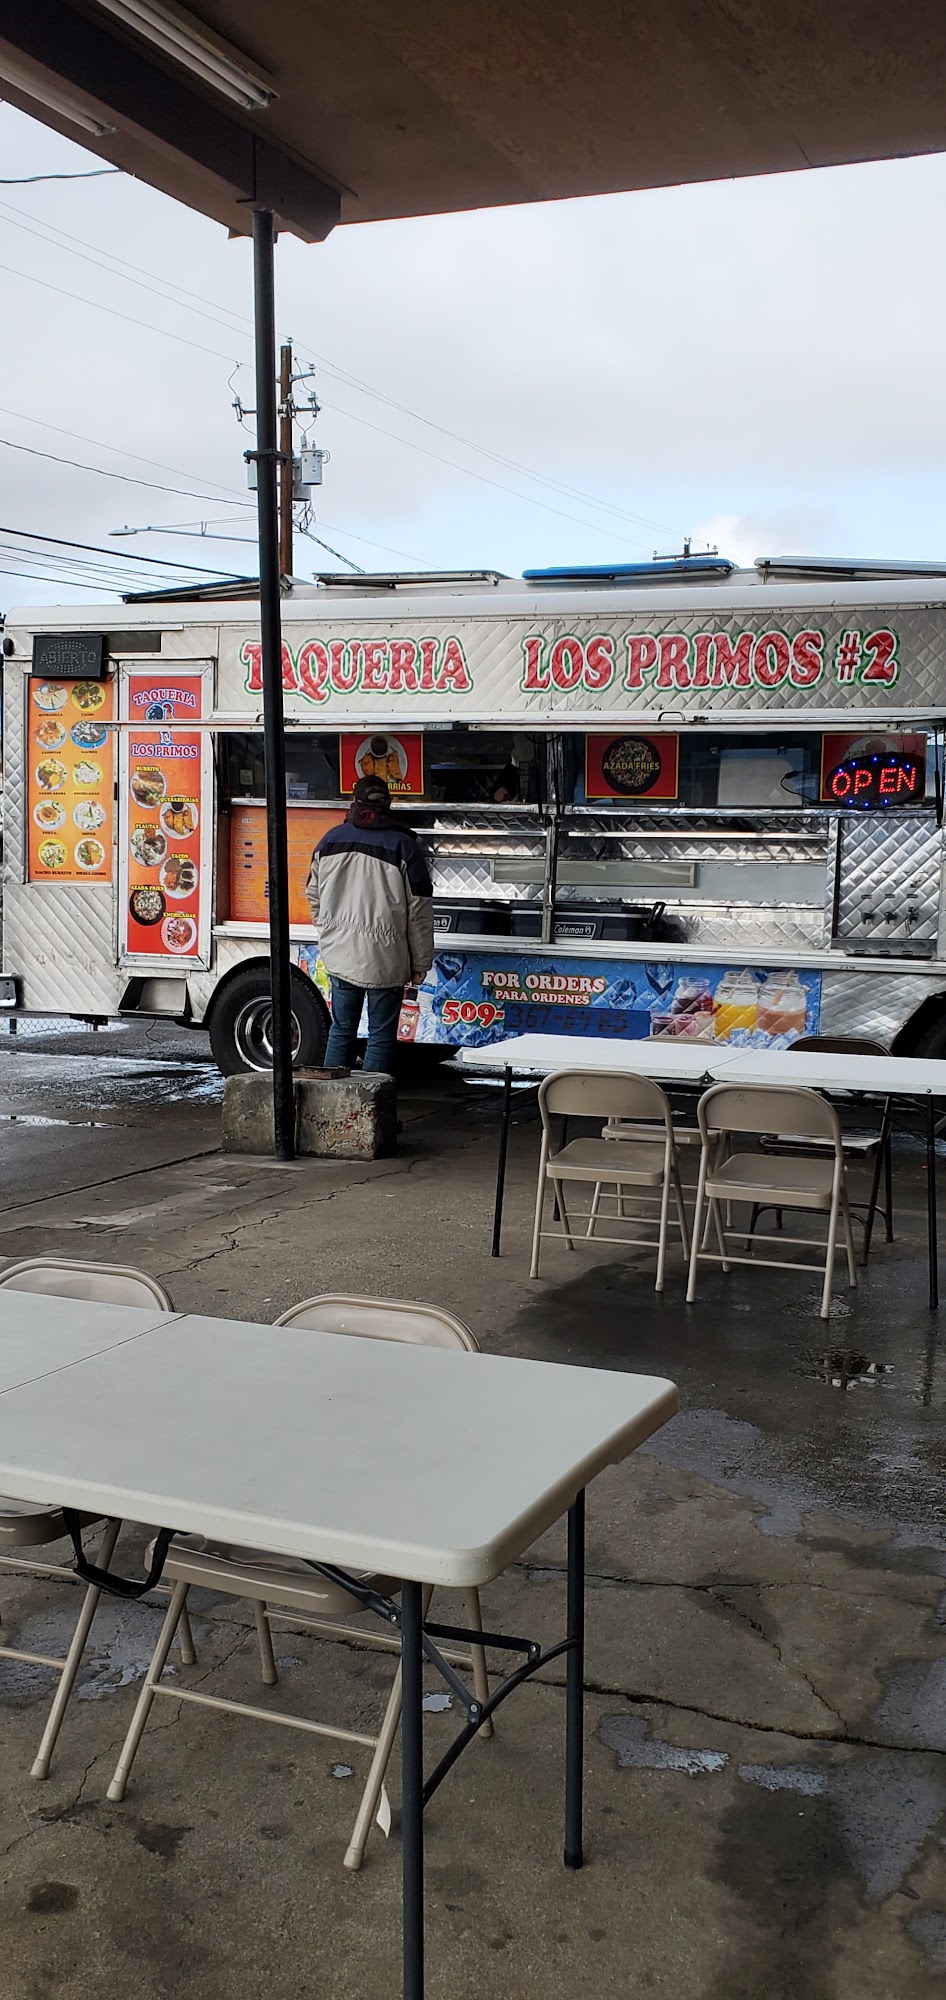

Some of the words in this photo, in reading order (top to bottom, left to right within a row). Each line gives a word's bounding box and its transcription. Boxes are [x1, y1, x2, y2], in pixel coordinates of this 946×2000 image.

[39, 651, 97, 664] ABIERTO
[522, 635, 614, 690] LOS
[625, 630, 824, 689] PRIMOS
[836, 629, 899, 685] #2
[242, 637, 473, 704] TAQUERIA
[132, 688, 198, 708] TAQUERIA
[132, 744, 153, 757] LOS
[155, 745, 198, 758] PRIMOS
[603, 761, 634, 770] AZADA
[635, 762, 660, 770] FRIES
[831, 767, 917, 796] OPEN
[554, 923, 585, 935] Coleman
[481, 971, 521, 988] FOR
[525, 974, 606, 993] ORDERS
[494, 989, 529, 1002] PARA
[531, 991, 591, 1005] ORDENES
[441, 1000, 505, 1028] 509-
